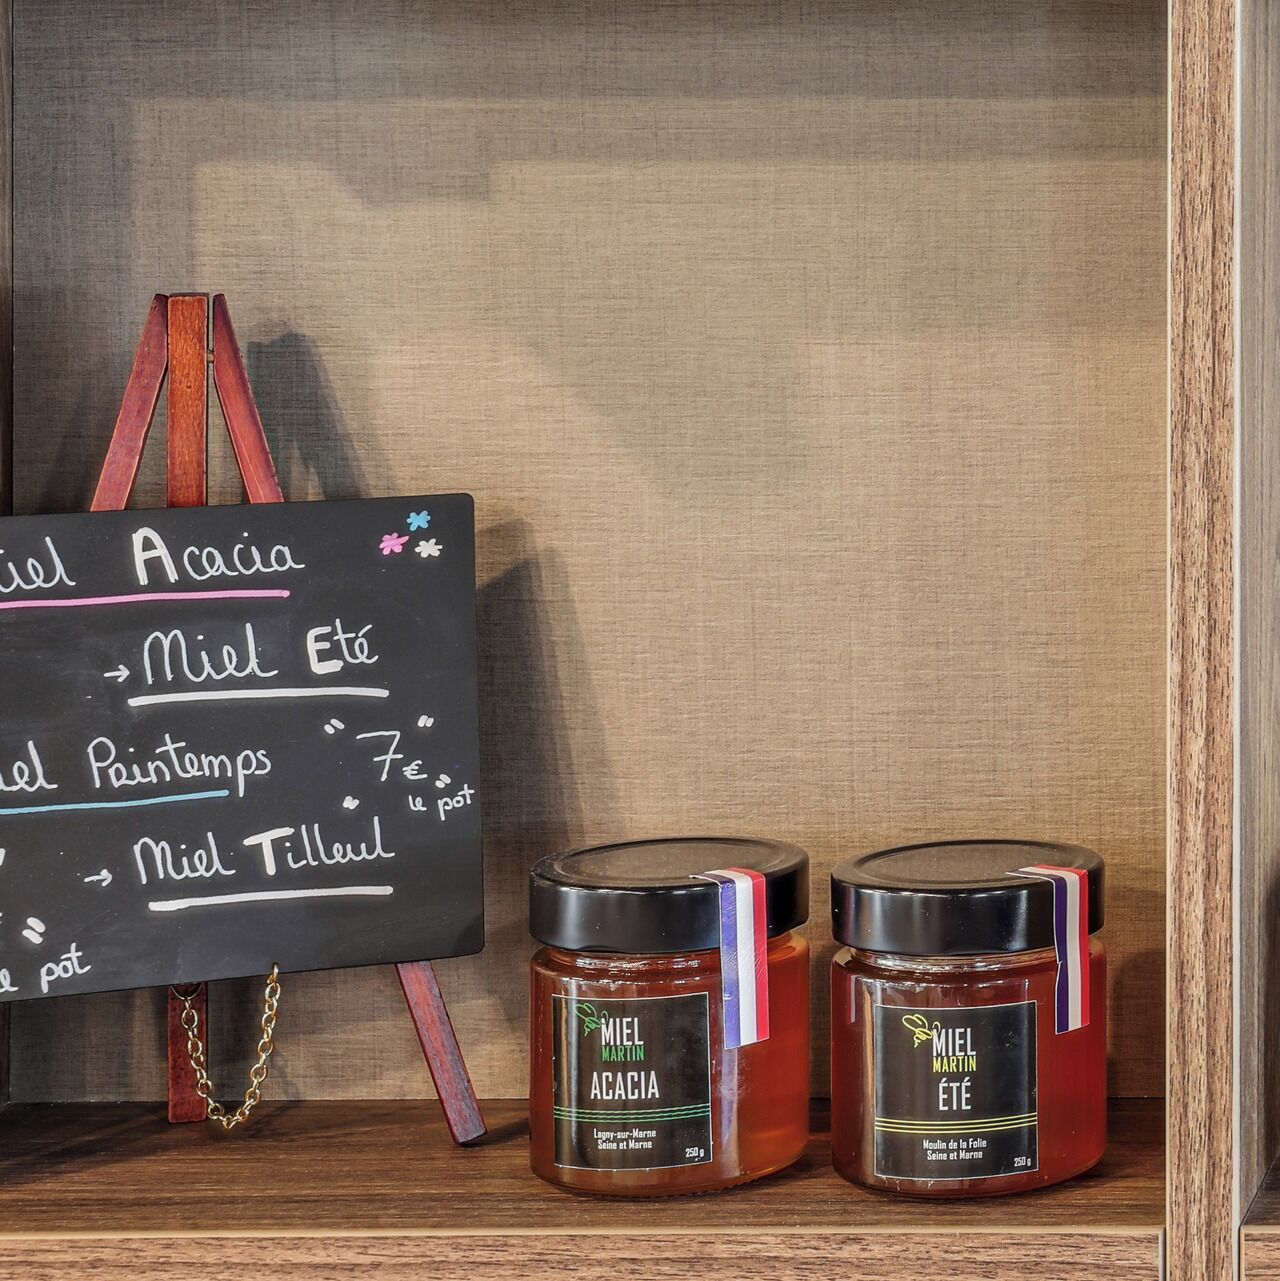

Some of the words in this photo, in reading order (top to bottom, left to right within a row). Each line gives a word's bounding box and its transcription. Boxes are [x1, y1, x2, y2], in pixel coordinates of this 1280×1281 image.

[132, 526, 305, 585] Acacia
[143, 623, 278, 686] Miel
[307, 618, 379, 676] Eté
[87, 733, 271, 797] Printemps
[438, 784, 475, 821] pot
[133, 832, 235, 885] Miel
[243, 816, 395, 876] Tilleul
[41, 943, 91, 994] pot
[601, 1017, 644, 1046] MIEL
[933, 1027, 976, 1056] MIEL
[602, 1045, 644, 1062] MARTIN
[933, 1056, 976, 1073] MARTIN
[590, 1070, 659, 1100] ACACIA
[938, 1078, 972, 1111] ÉTÉ
[594, 1128, 656, 1141] Lagny-sur-Marne
[598, 1139, 617, 1150] Seine
[629, 1139, 653, 1149] Marne
[923, 1139, 946, 1150] Moulin
[969, 1138, 987, 1149] Folie
